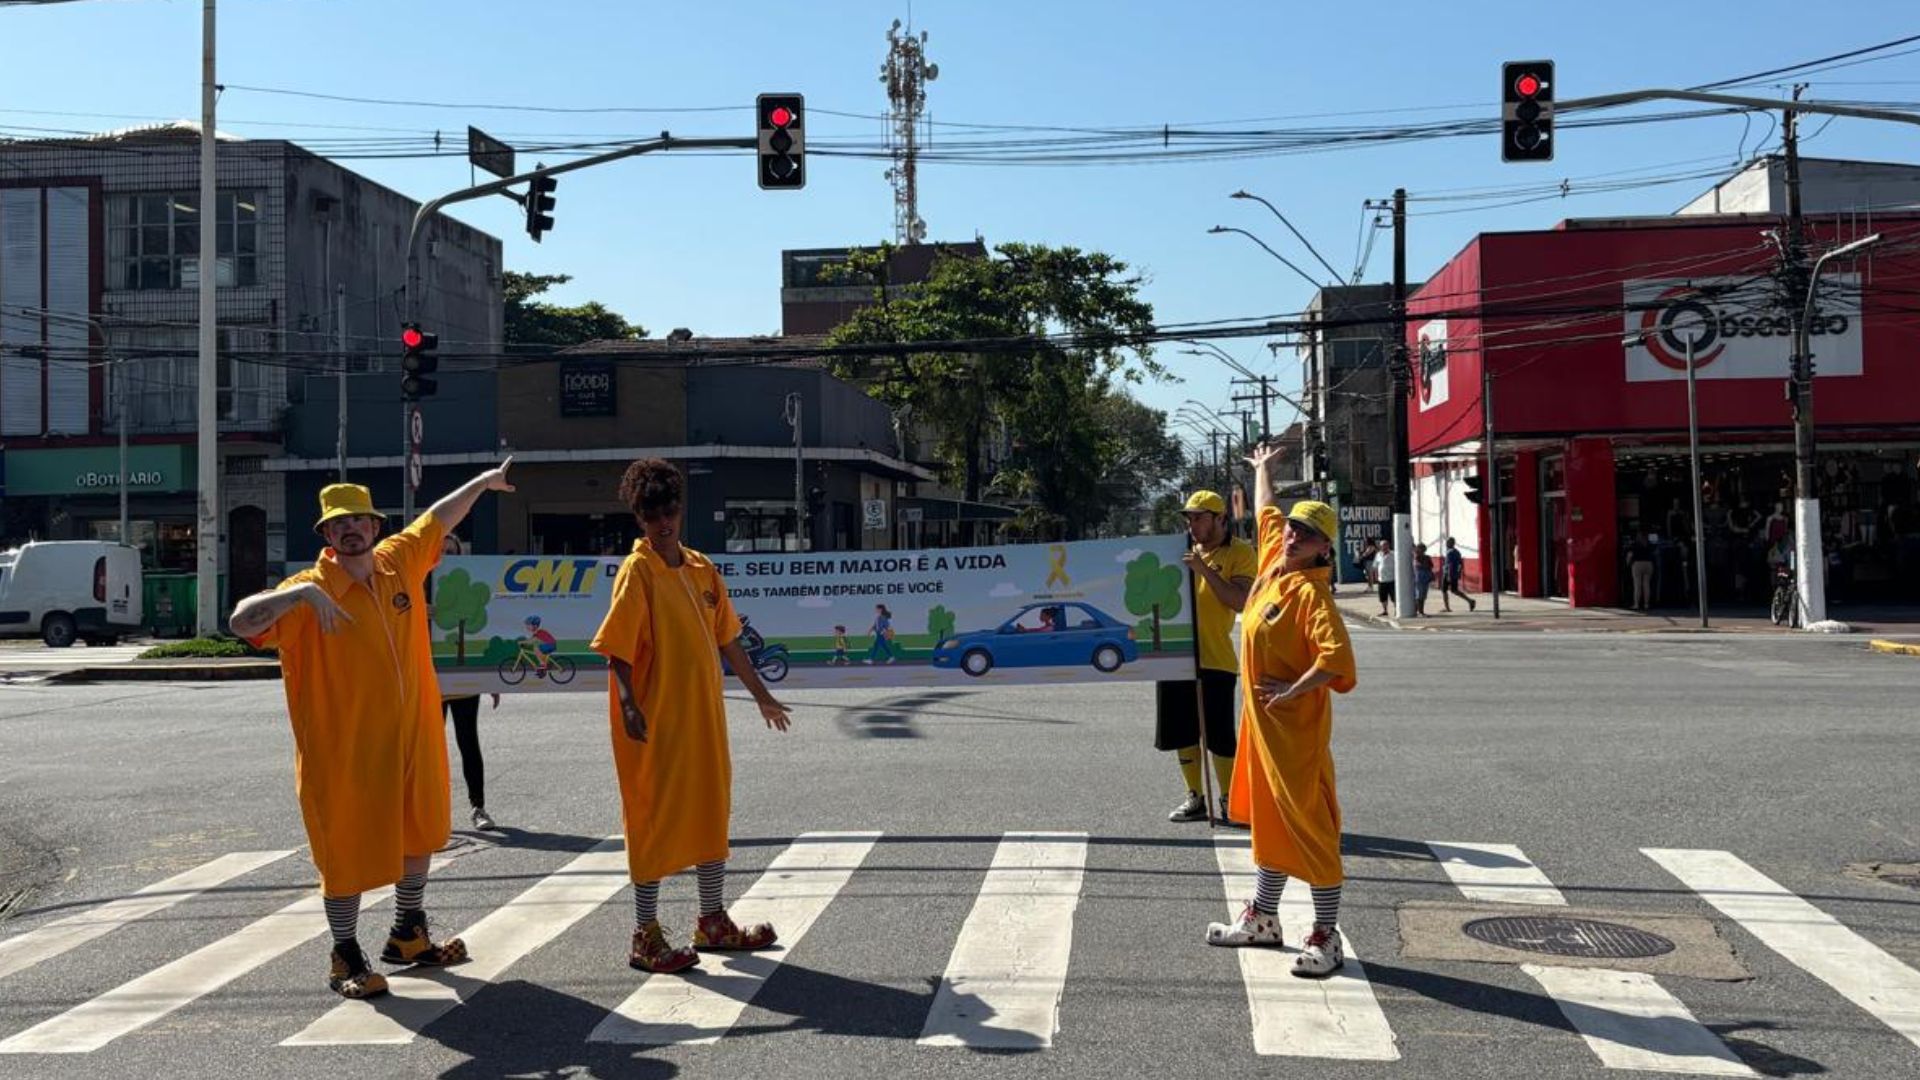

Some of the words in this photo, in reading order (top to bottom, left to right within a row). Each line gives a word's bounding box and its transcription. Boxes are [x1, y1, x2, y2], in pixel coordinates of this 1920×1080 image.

[503, 559, 598, 593] CMT
[745, 561, 784, 577] SEU
[789, 560, 835, 576] BEM
[840, 558, 911, 574] MAIOR
[917, 555, 929, 571] É
[935, 556, 949, 570] A
[954, 554, 1006, 570] VIDA
[727, 588, 759, 598] IDAS
[763, 585, 820, 598] TAMBÉM
[823, 583, 883, 597] DEPENDE
[887, 583, 905, 594] DE
[908, 580, 944, 594] VOCÊ
